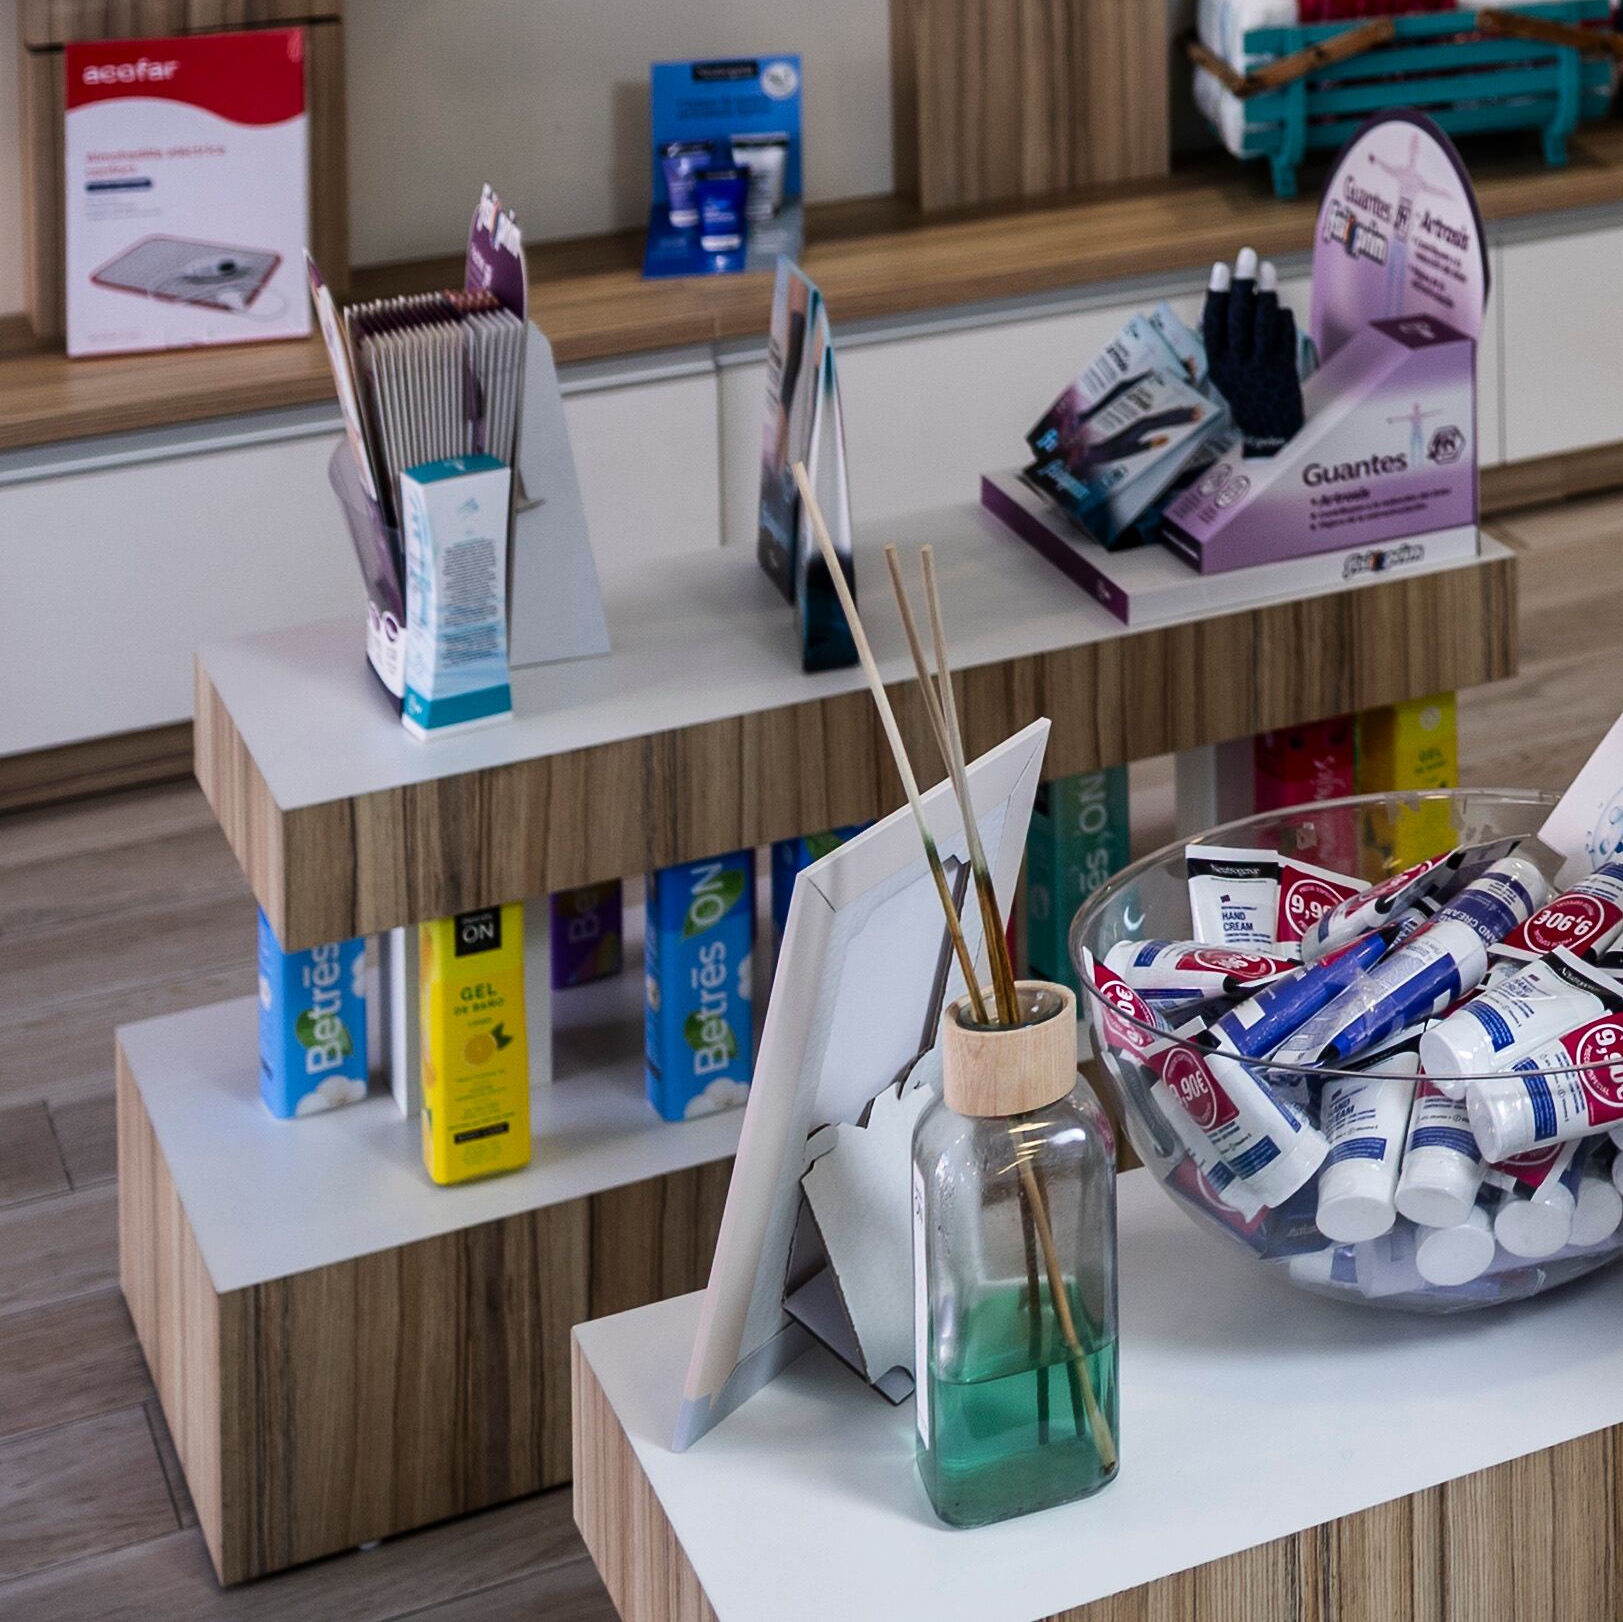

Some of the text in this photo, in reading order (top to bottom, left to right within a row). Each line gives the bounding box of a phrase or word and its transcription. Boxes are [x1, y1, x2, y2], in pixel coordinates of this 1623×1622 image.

[82, 55, 179, 86] acofar
[1302, 452, 1409, 487] Guantes
[1221, 911, 1246, 921] HAND
[1291, 894, 1333, 920] 9,9
[461, 919, 496, 944] ON
[1223, 921, 1254, 932] CREAM
[1533, 910, 1594, 935] 9,90€
[459, 982, 498, 1002] GEL
